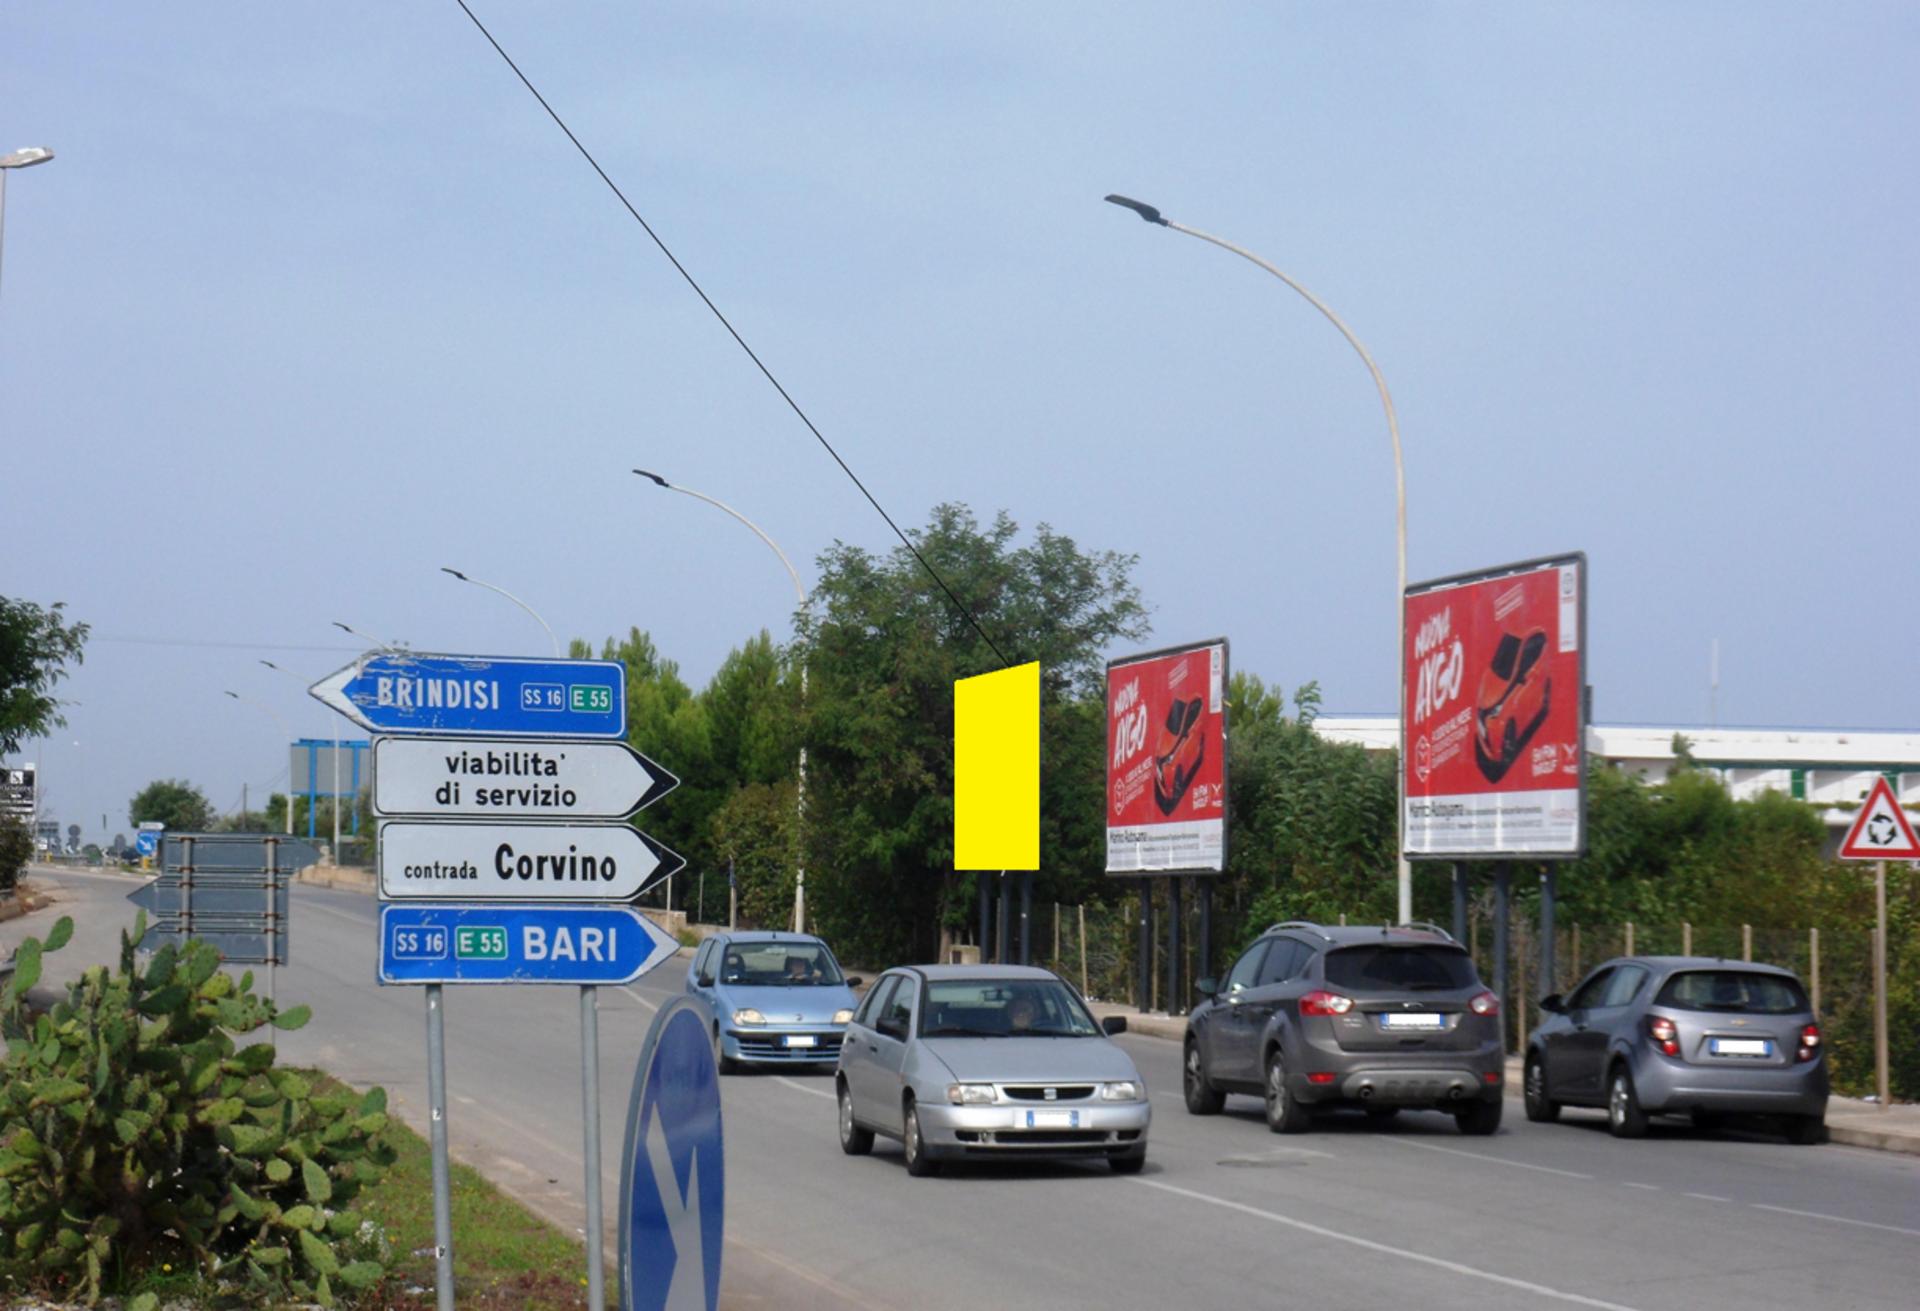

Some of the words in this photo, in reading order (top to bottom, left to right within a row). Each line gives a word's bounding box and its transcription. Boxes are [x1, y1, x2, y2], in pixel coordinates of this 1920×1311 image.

[377, 677, 499, 710] BRINDISI
[1414, 640, 1464, 725] AYGO
[524, 689, 541, 705] SS
[546, 690, 562, 706] 16
[573, 690, 584, 707] E
[590, 690, 609, 708] 55
[446, 751, 565, 776] viabilita'
[435, 781, 460, 805] di
[475, 784, 577, 807] servizio
[404, 861, 478, 880] contrada
[495, 843, 617, 881] Corvino
[397, 933, 417, 952] SS
[425, 933, 444, 952] 16
[460, 932, 473, 952] E
[480, 932, 503, 953] 55
[523, 926, 617, 962] BARI
